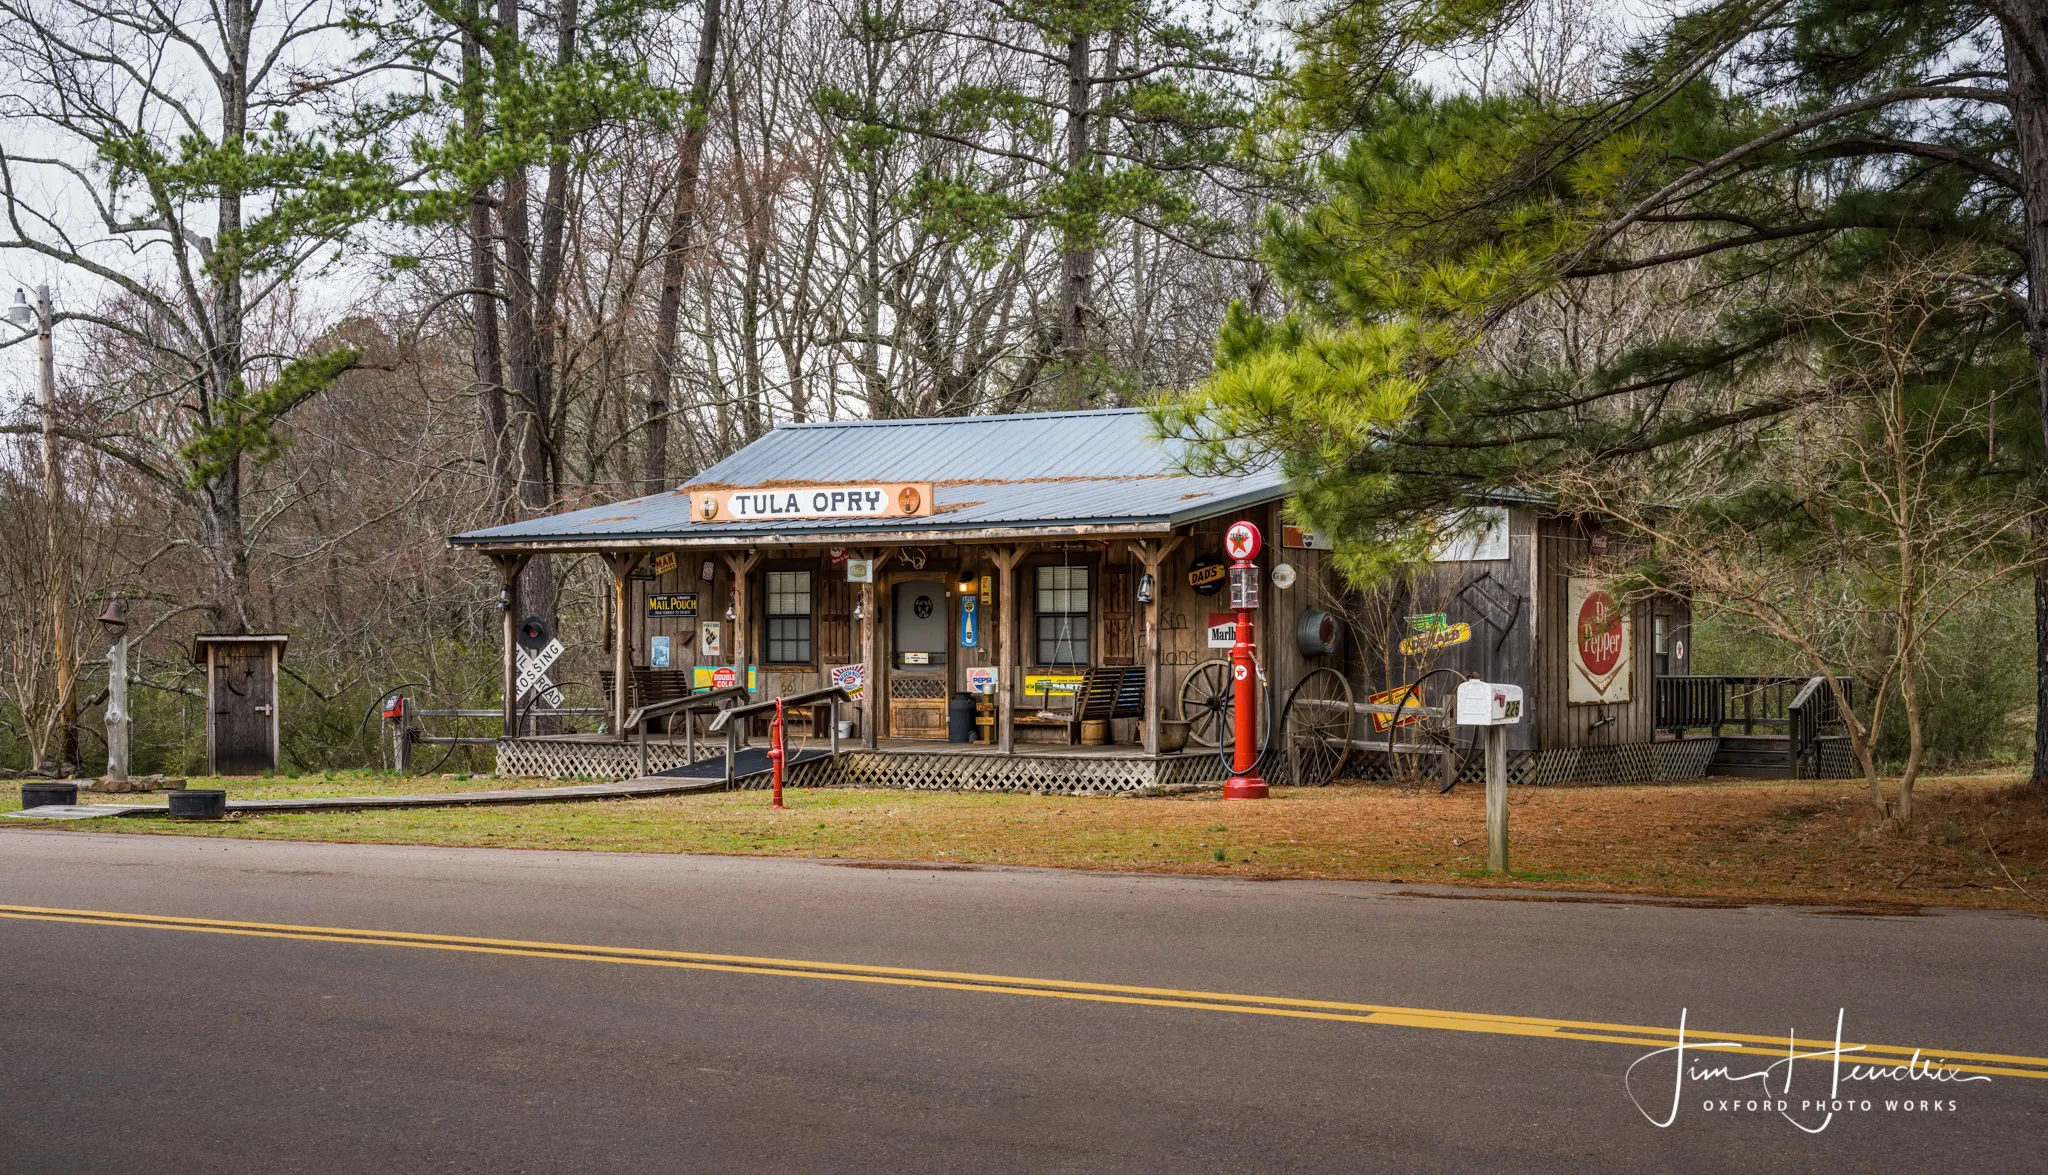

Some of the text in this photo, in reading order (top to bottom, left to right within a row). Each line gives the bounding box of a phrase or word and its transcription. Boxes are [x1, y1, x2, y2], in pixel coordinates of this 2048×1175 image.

[735, 493, 800, 514] TULA
[813, 491, 880, 512] OPRY
[670, 596, 697, 610] POUCH
[1211, 626, 1236, 641] Marlb
[1583, 623, 1620, 662] Pepper
[515, 644, 560, 696] ROSSING
[713, 673, 736, 681] DOUBLE
[716, 680, 733, 688] COLA
[1505, 700, 1521, 718] 226
